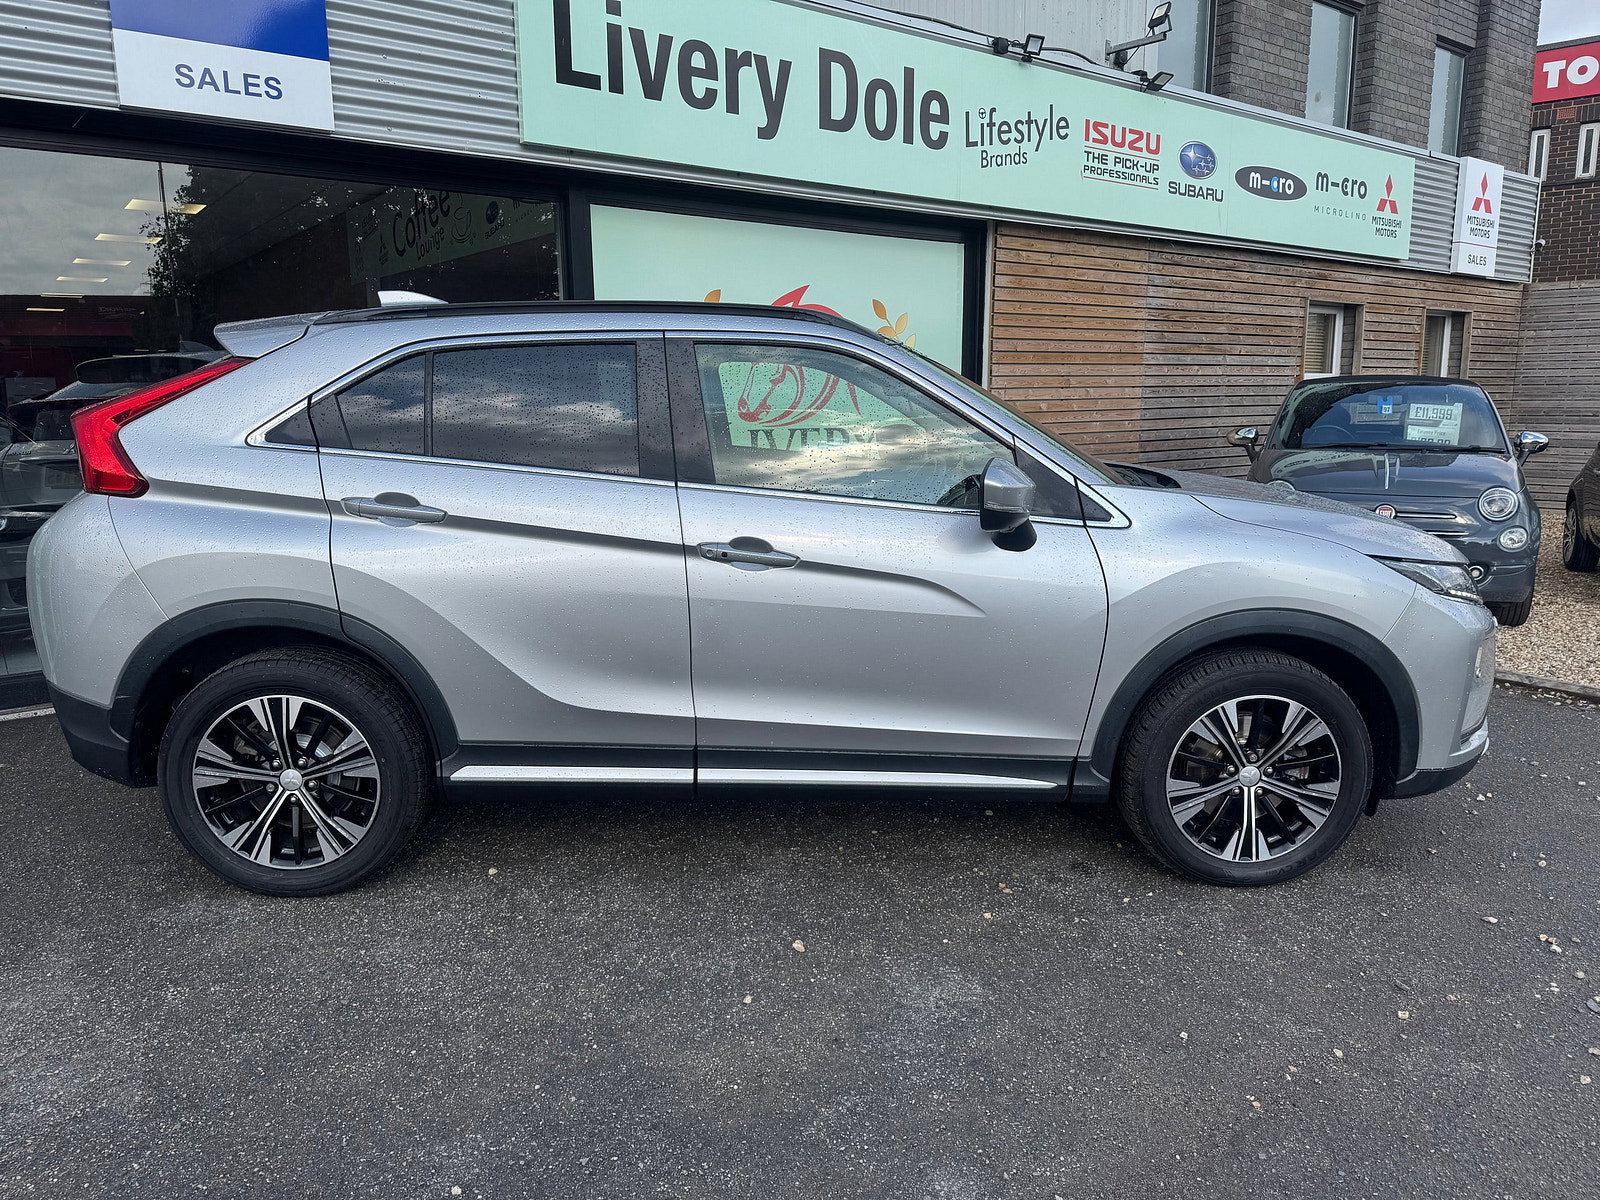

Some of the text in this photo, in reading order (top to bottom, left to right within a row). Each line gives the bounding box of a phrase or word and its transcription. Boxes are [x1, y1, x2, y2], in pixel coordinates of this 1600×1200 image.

[175, 63, 284, 100] SALES
[553, 0, 950, 150] Livery Dole
[965, 104, 1070, 152] Lifestyle
[1084, 119, 1161, 155] ISUZU
[981, 146, 1028, 168] Brands
[1084, 150, 1160, 174] THE PICK-UP
[1083, 164, 1160, 186] PROFESSIONALS
[1168, 181, 1224, 203] SUBARU
[393, 189, 450, 256] Coffee
[1313, 205, 1367, 221] MICROLINO
[1372, 215, 1402, 230] MITSUBISHI
[1467, 214, 1495, 230] MITSUBISHI
[1375, 226, 1398, 239] MOTORS
[1469, 226, 1491, 239] MOTORS
[1467, 254, 1488, 267] SALES
